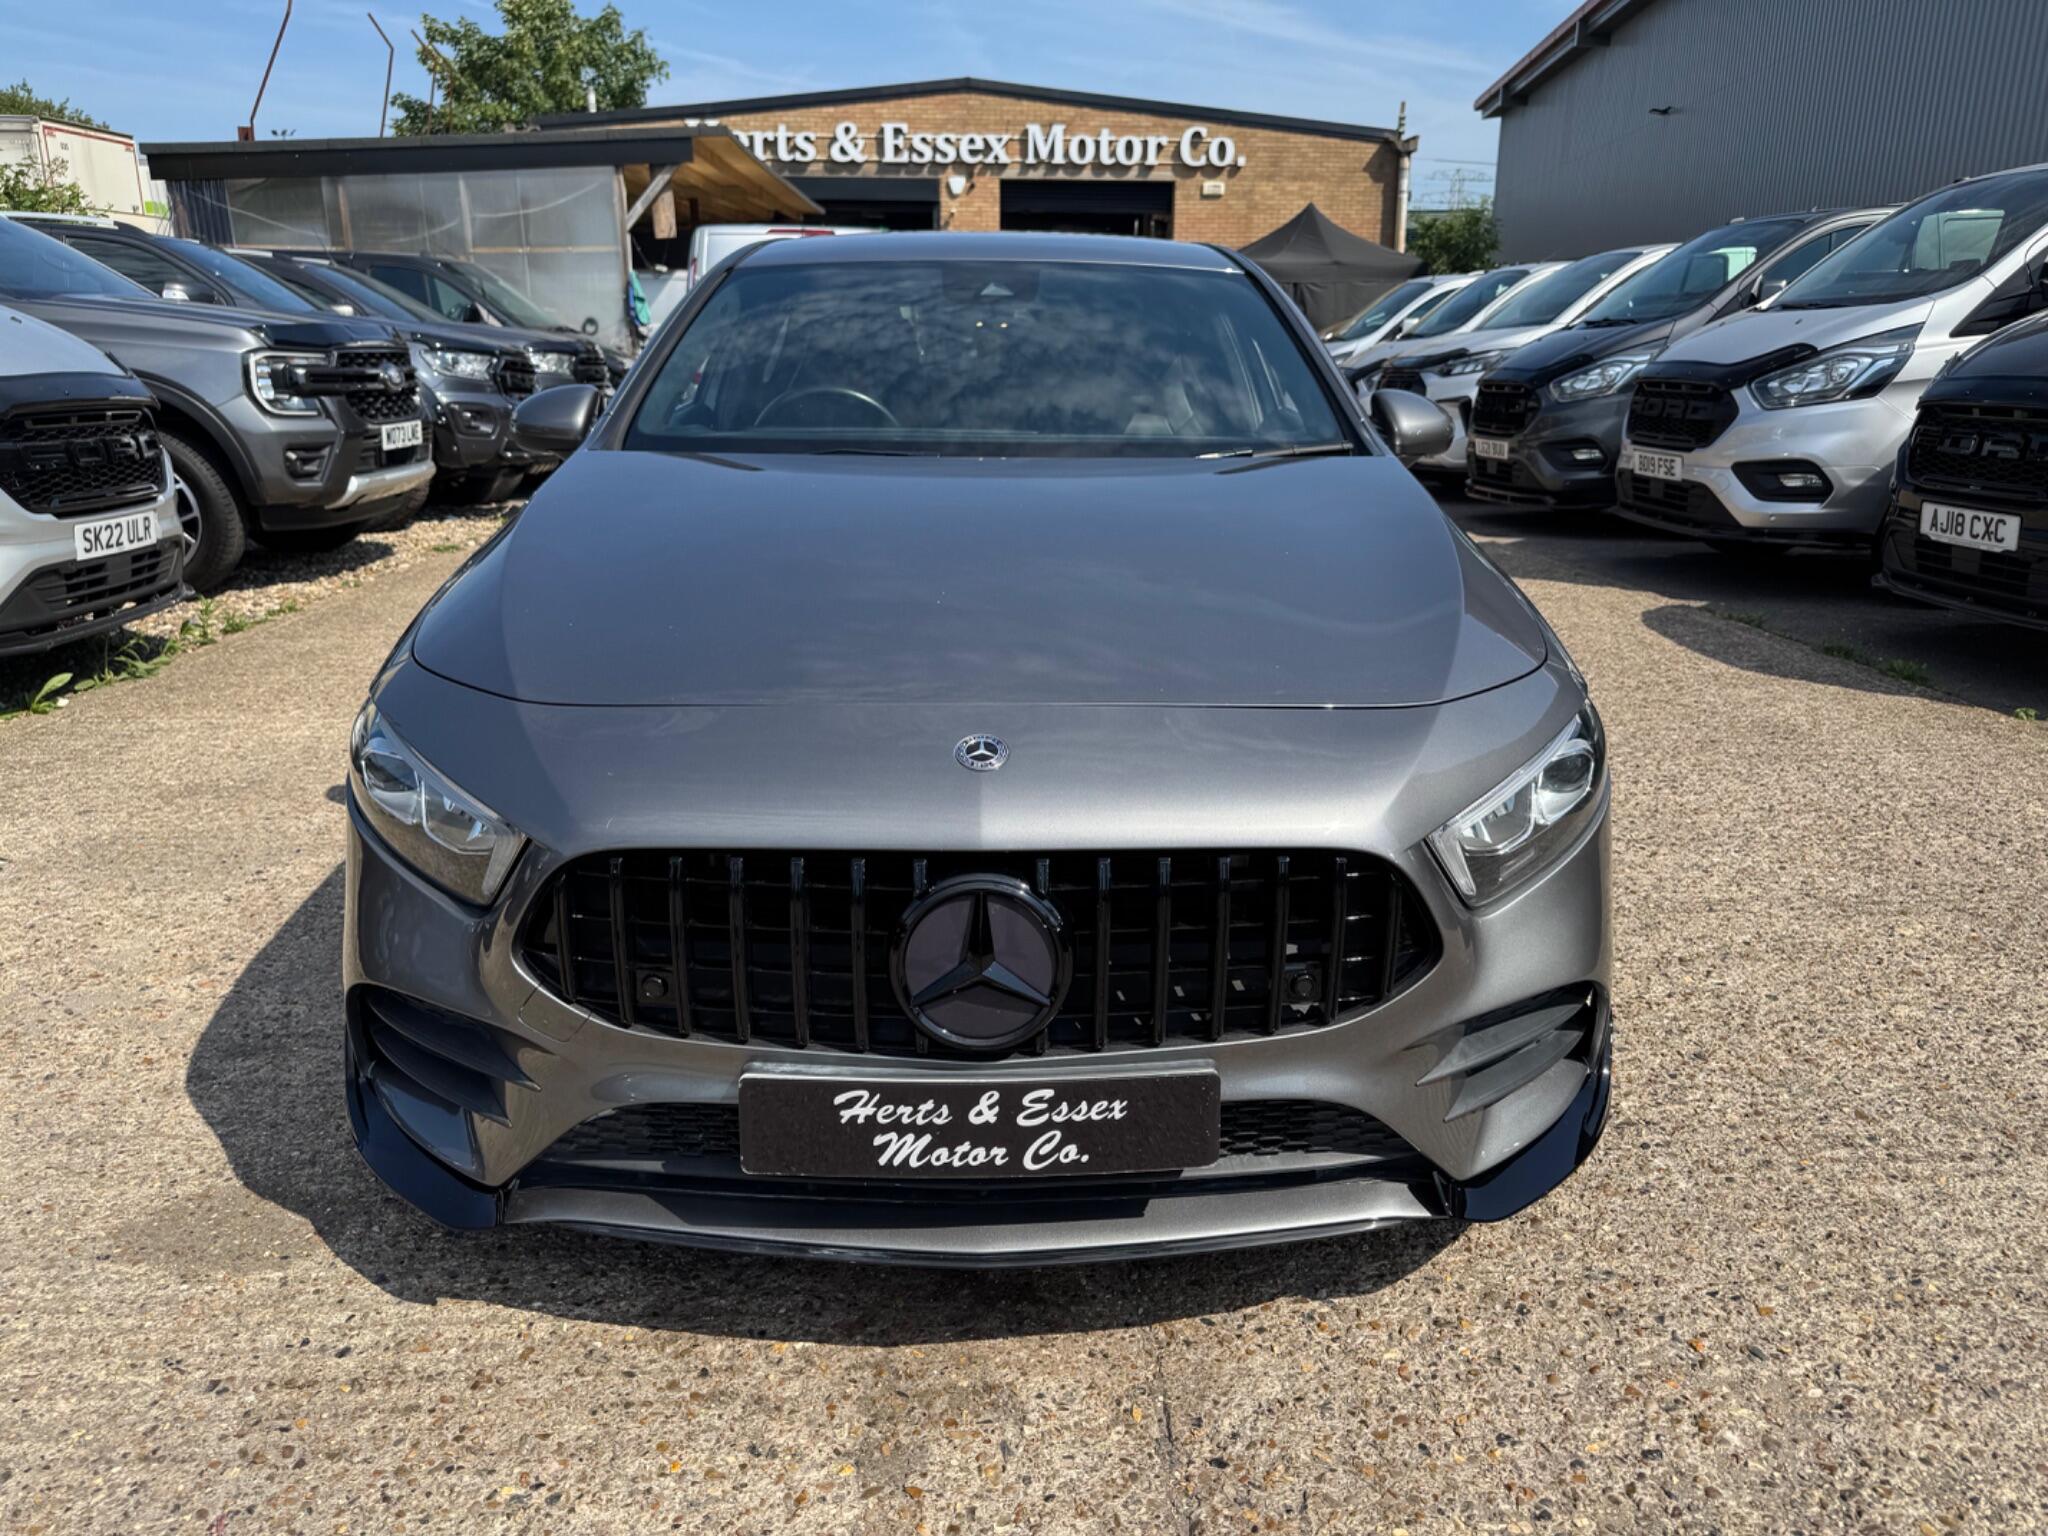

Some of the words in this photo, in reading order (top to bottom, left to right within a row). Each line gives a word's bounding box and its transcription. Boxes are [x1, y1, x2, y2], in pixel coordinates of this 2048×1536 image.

[830, 121, 868, 164] &
[880, 122, 1013, 165] Essex
[1024, 123, 1169, 167] Motor
[1179, 126, 1247, 168] Co.
[82, 522, 124, 553] SK22
[127, 516, 152, 543] ULR
[1929, 507, 1966, 537] AJ18
[1969, 514, 2007, 543] CXC
[833, 1089, 952, 1126] Herts
[968, 1090, 1000, 1125] &
[1015, 1088, 1128, 1127] Essex
[872, 1131, 1009, 1169] Motor
[1022, 1129, 1090, 1171] Co.
